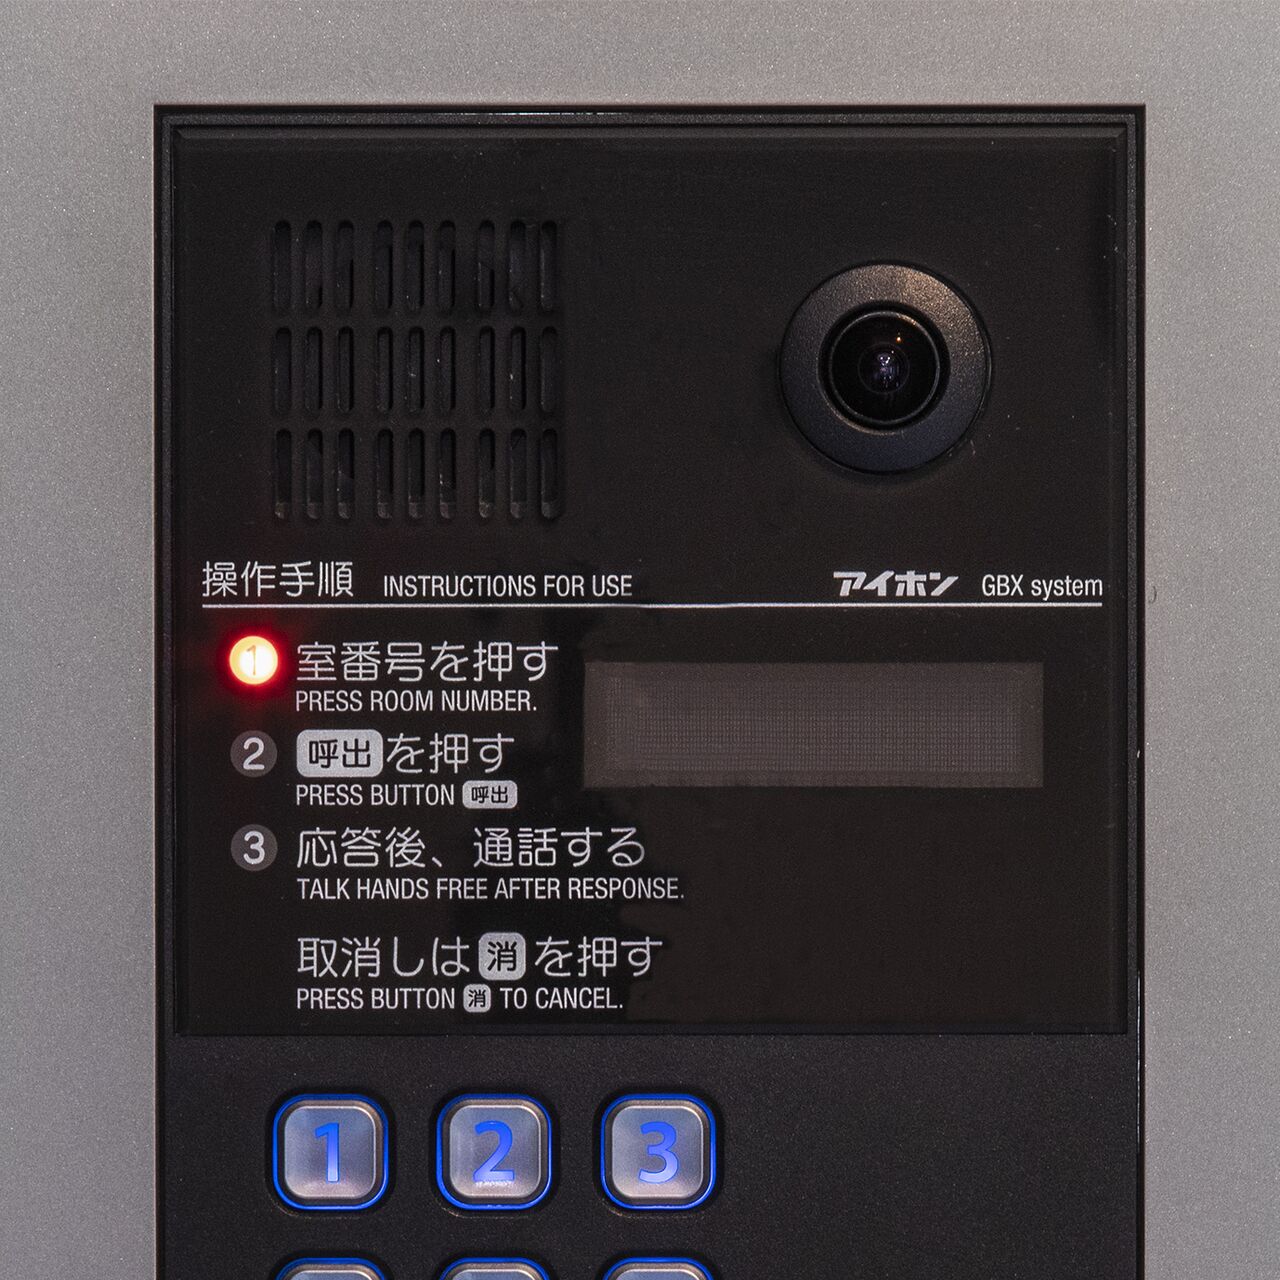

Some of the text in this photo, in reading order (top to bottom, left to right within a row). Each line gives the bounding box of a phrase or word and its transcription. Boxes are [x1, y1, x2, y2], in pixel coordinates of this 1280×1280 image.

[202, 560, 354, 598] 操作手順
[383, 574, 633, 597] INSTRUCTIONS FOR USE
[833, 570, 959, 597] アイホン
[981, 573, 1103, 602] GBX system
[296, 640, 559, 682] 室番号を押す
[295, 690, 537, 712] PRESS ROOM NUMBER.
[242, 737, 265, 770] 2
[295, 784, 509, 806] PRESS BUTTON 呼出
[243, 830, 266, 865] 3
[297, 877, 684, 900] TALK HANDS FREE AFTER RESPONSE.
[296, 987, 624, 1010] PRESS BUTTON 消 TO CANCEL.
[313, 1119, 681, 1184] 1 2 3
